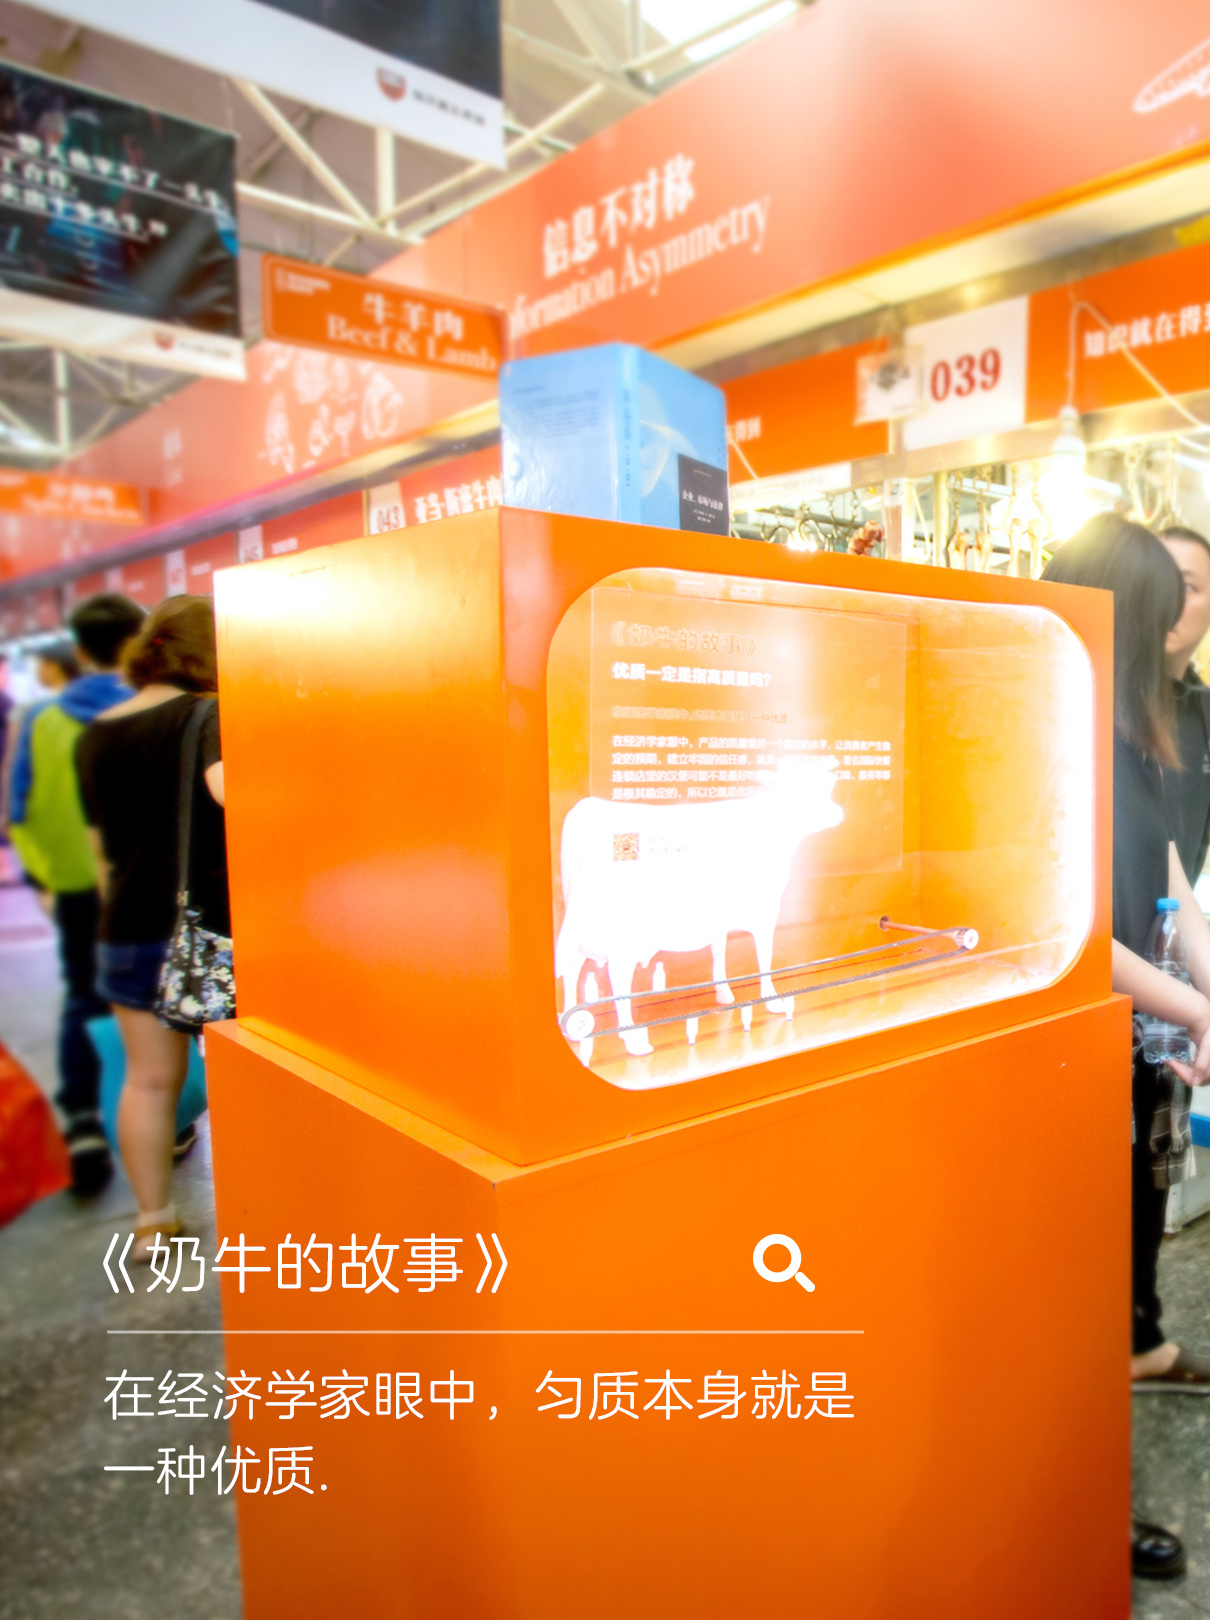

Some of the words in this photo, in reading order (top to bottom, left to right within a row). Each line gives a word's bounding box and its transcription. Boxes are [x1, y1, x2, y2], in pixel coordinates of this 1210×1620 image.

[543, 153, 696, 280] 信息不对称
[619, 195, 772, 297] Asymmetry
[327, 313, 392, 350] Beef
[395, 330, 419, 357] &
[427, 336, 498, 372] Lamb
[364, 293, 464, 342] 牛羊肉
[930, 347, 1001, 403] 039
[611, 620, 757, 656] 《奶牛的故事》
